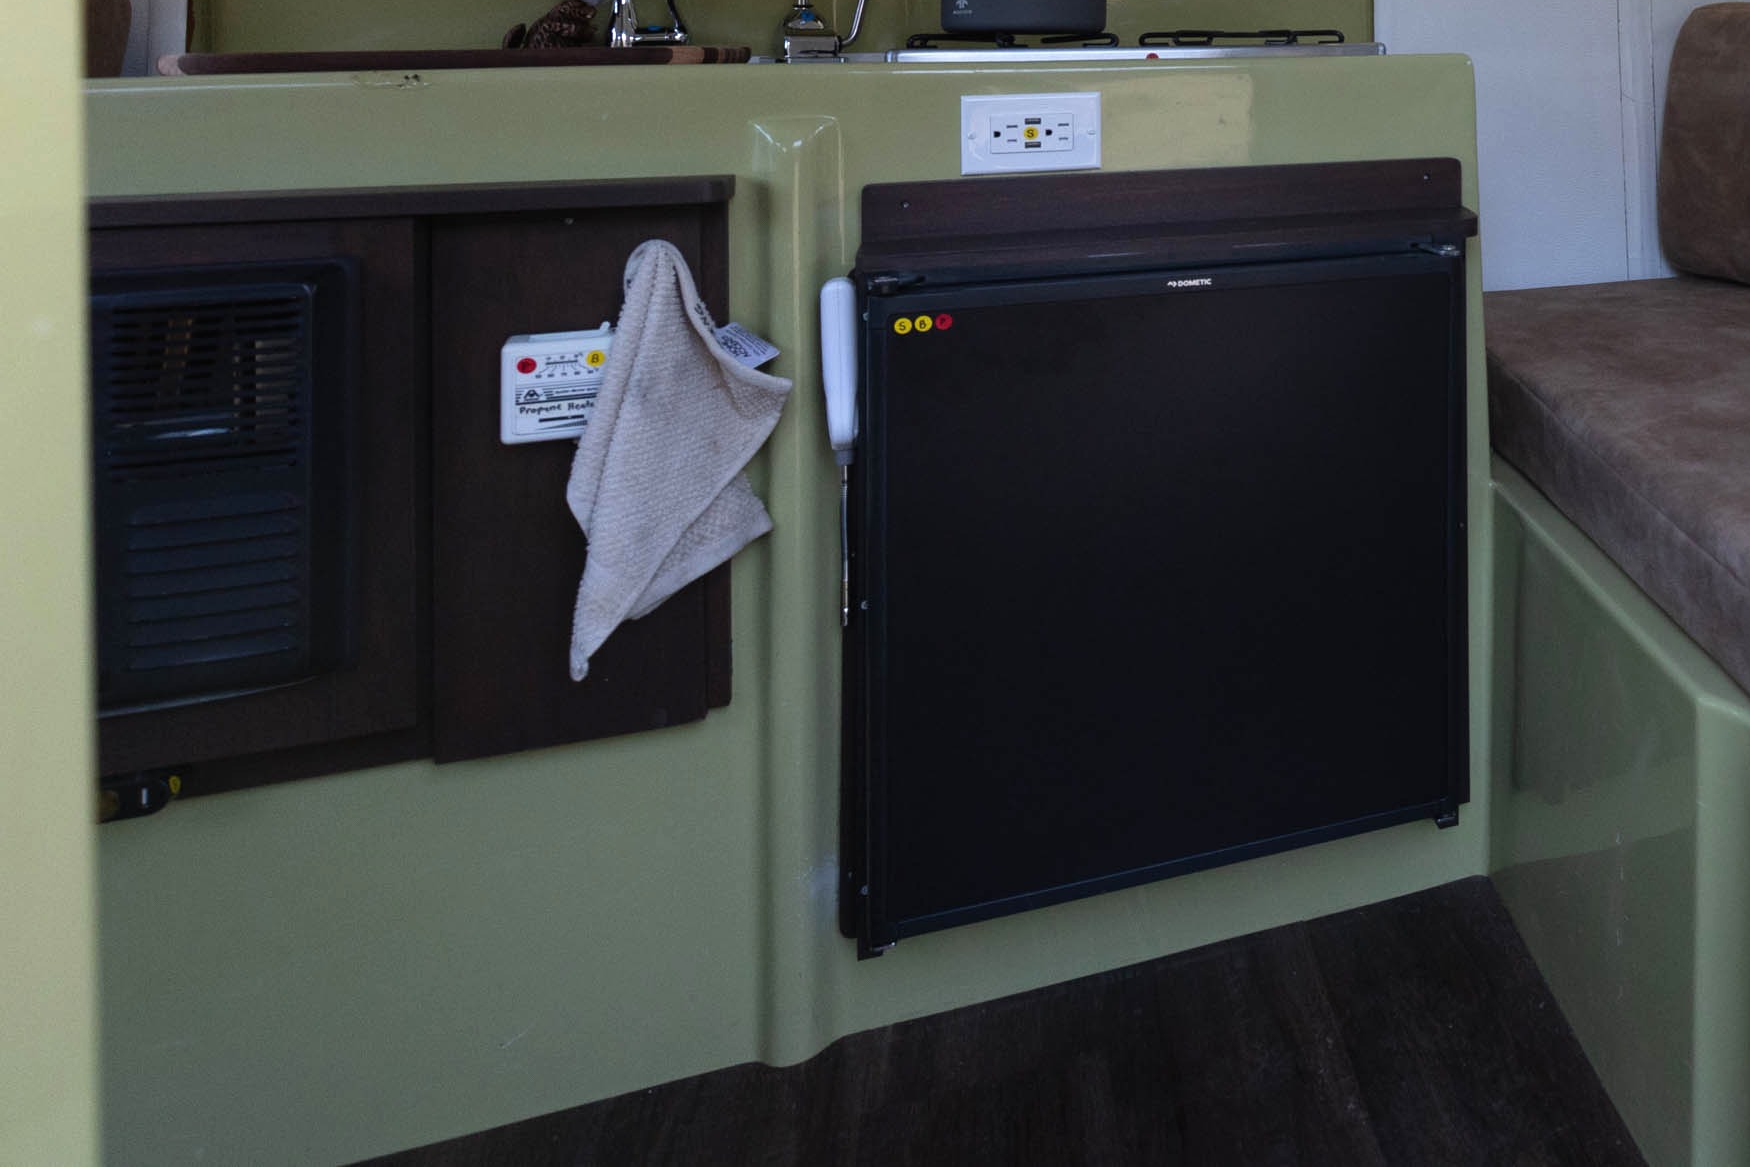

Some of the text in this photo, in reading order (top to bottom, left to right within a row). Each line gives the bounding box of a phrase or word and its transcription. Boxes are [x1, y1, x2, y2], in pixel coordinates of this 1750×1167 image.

[1177, 278, 1212, 288] DOMETIC
[519, 400, 596, 415] Propane Heate
